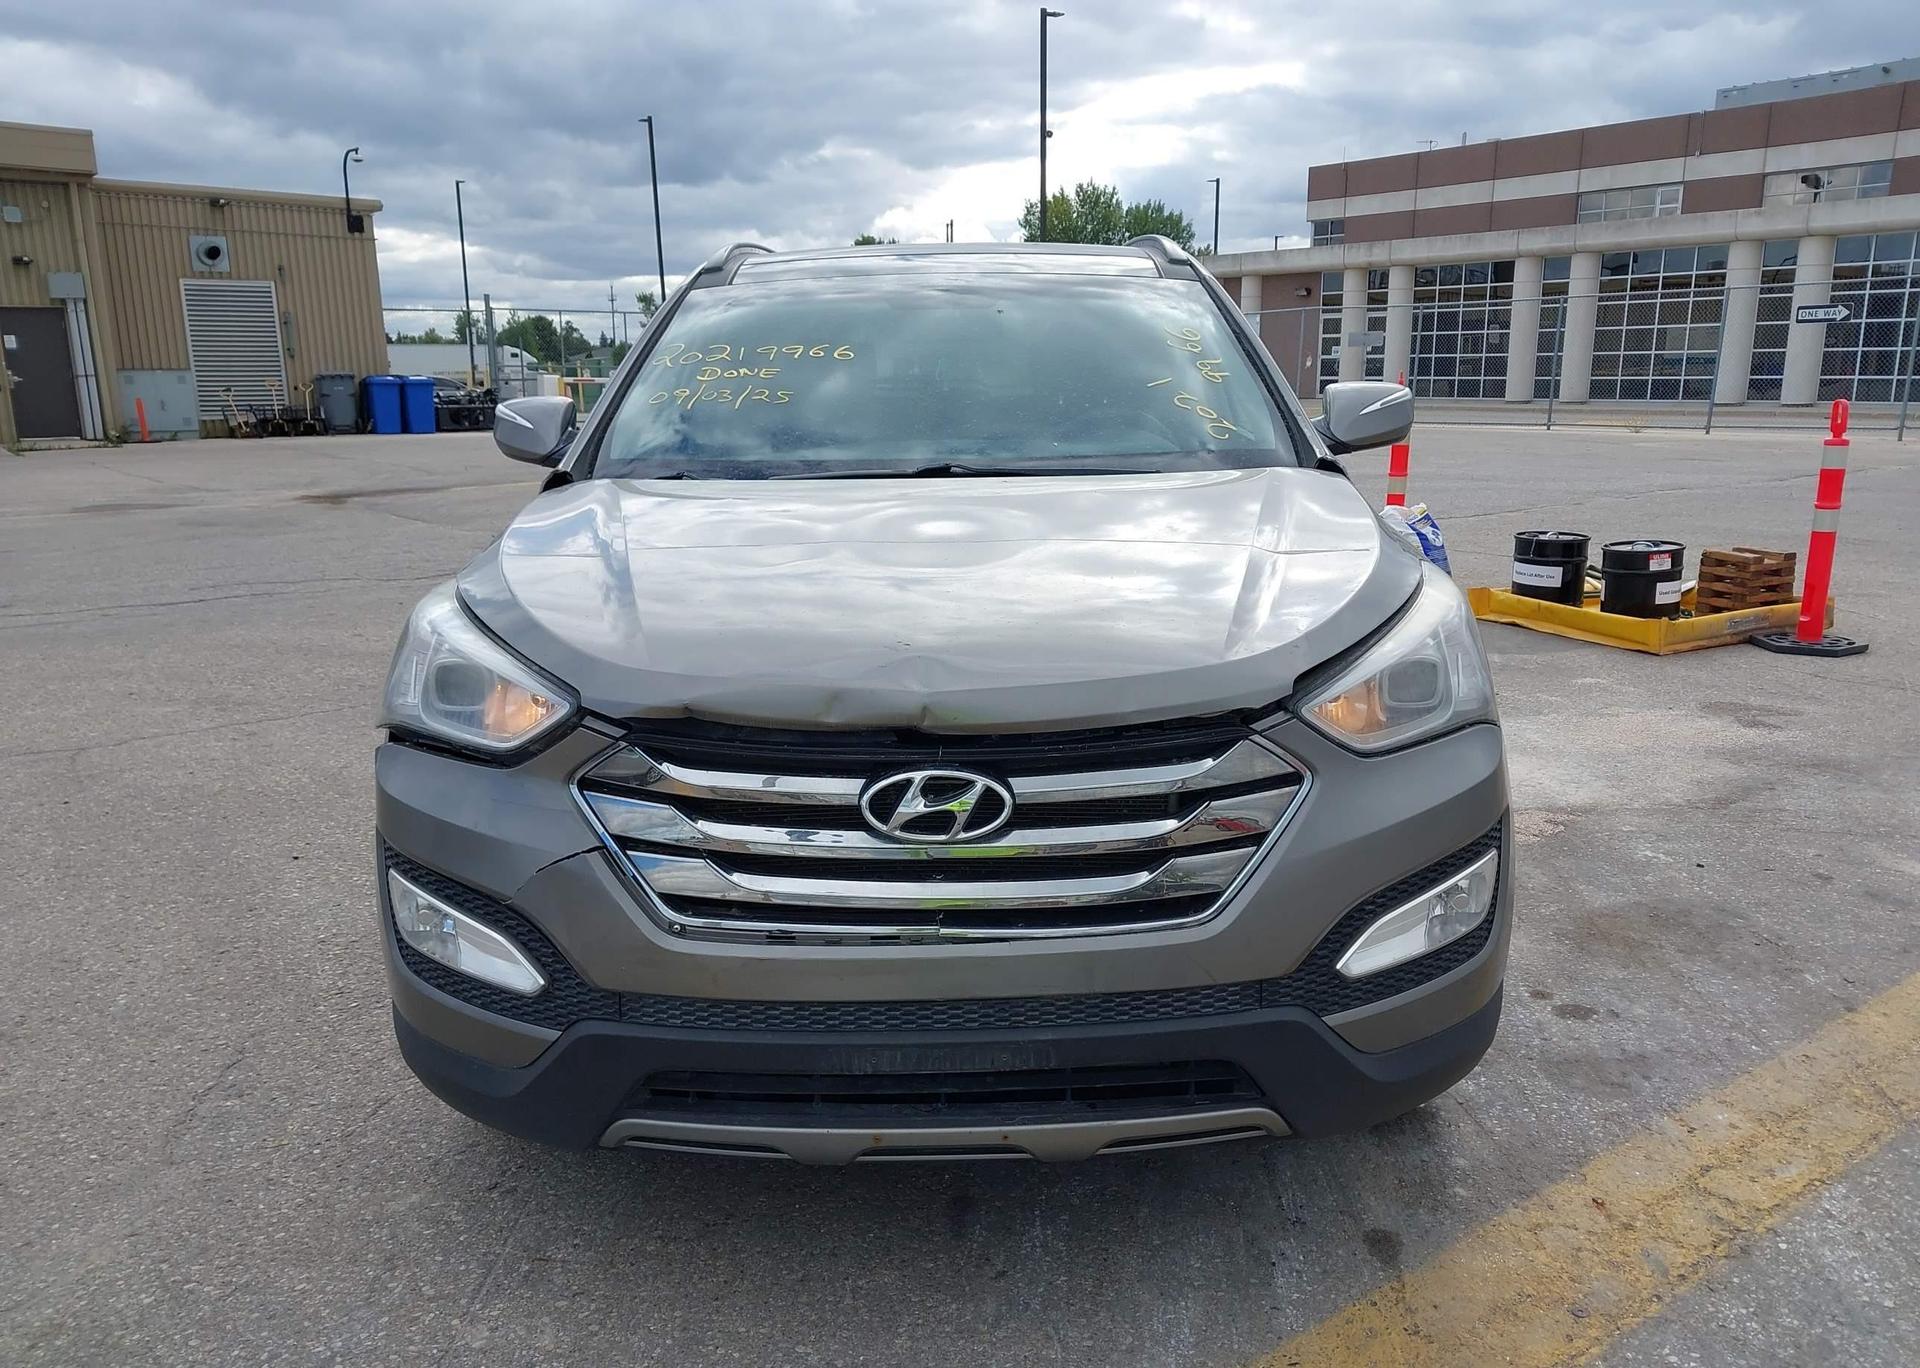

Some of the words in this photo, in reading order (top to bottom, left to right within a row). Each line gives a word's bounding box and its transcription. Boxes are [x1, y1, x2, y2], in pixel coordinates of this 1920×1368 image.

[1800, 310, 1819, 318] ONE
[1823, 309, 1843, 317] WAY
[696, 366, 781, 381] DONE
[648, 384, 794, 410] 09/03/25
